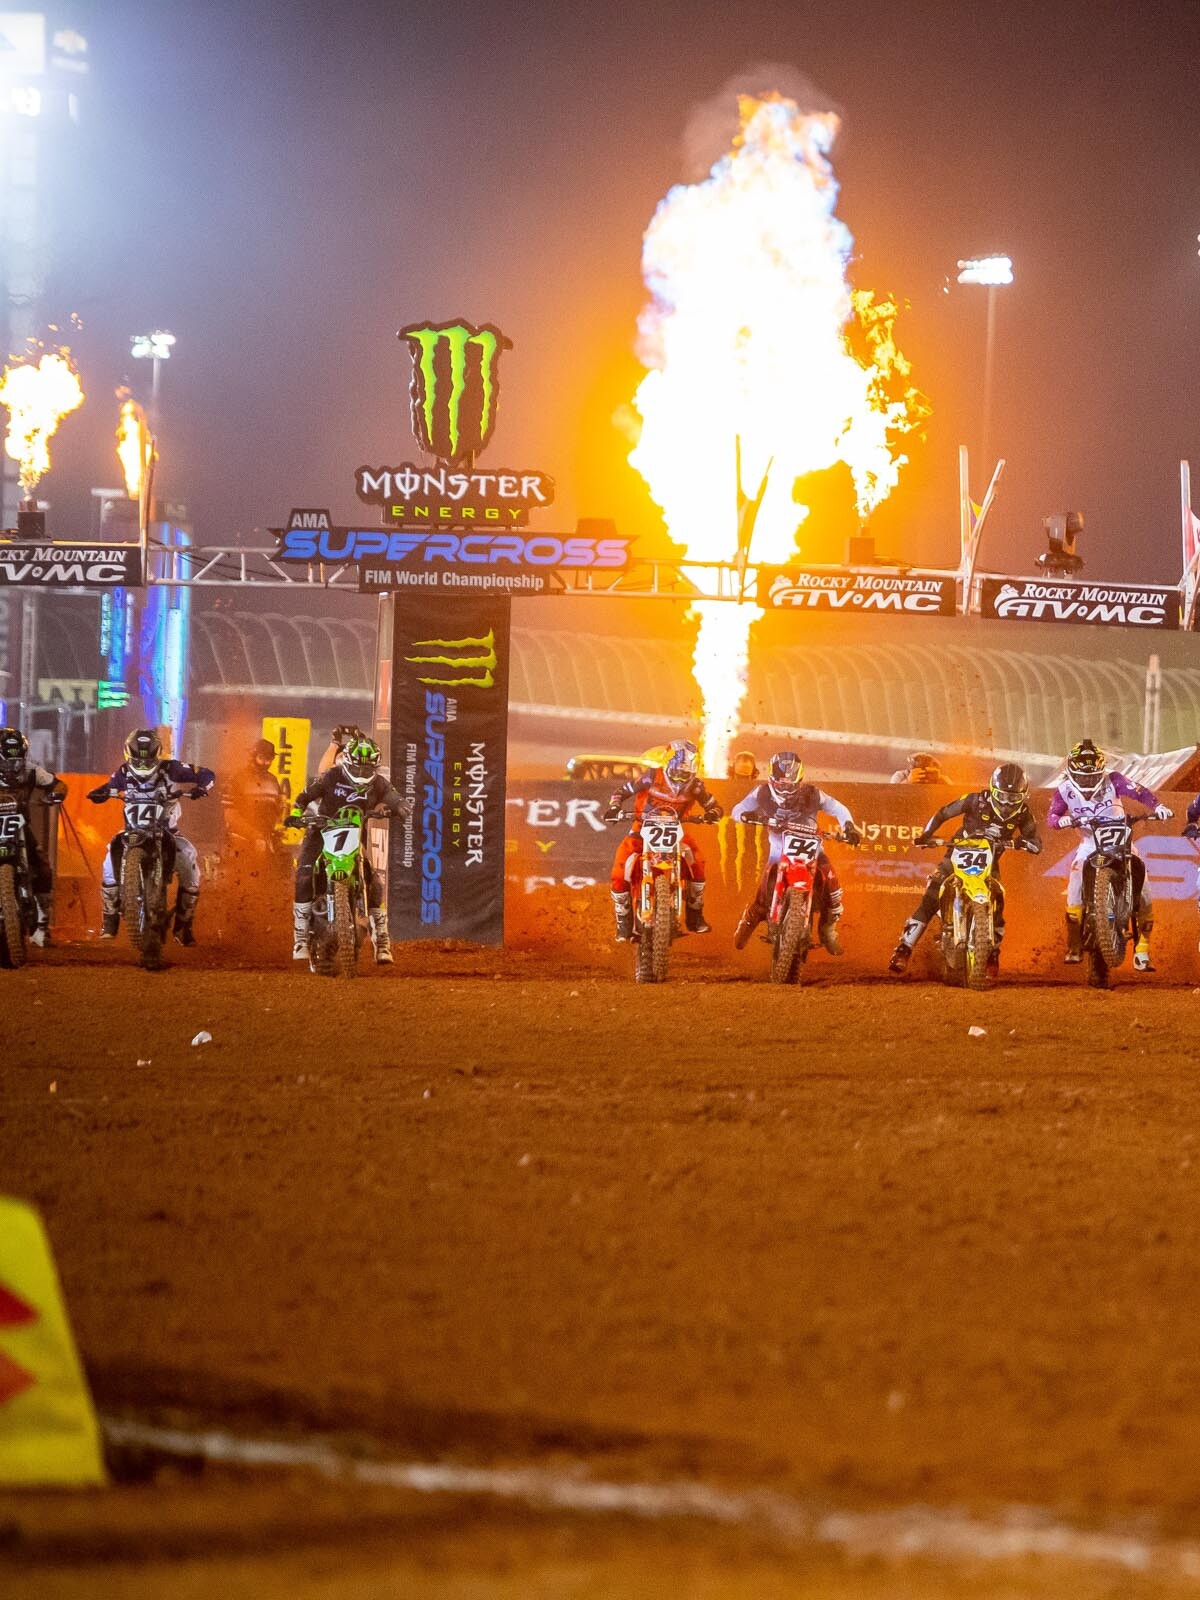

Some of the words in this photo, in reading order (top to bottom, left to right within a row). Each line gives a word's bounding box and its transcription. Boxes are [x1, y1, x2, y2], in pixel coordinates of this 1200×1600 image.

[361, 468, 546, 499] MONSTER
[291, 513, 329, 528] AMA
[392, 505, 522, 519] ENERGY
[32, 547, 127, 562] MOUNTAIN
[282, 531, 631, 567] SUPERCROSS
[365, 571, 392, 584] FIM
[396, 572, 438, 586] World
[442, 573, 544, 590] Championship
[796, 573, 849, 589] ROCKY
[853, 576, 943, 593] MOUNTAIN
[1021, 583, 1076, 600] ROCKY
[1079, 586, 1168, 606] MOUNTAIN
[446, 697, 457, 722] AMA
[406, 743, 417, 762] FIM
[405, 764, 416, 794] World
[421, 690, 447, 926] SUPERCROSS
[453, 762, 461, 848] ENERGY
[465, 743, 488, 867] MONSTER
[127, 805, 157, 828] 14
[333, 830, 350, 853] 1
[649, 827, 678, 847] 25
[1099, 828, 1127, 847] 27
[788, 839, 816, 859] 94
[957, 852, 988, 869] 34
